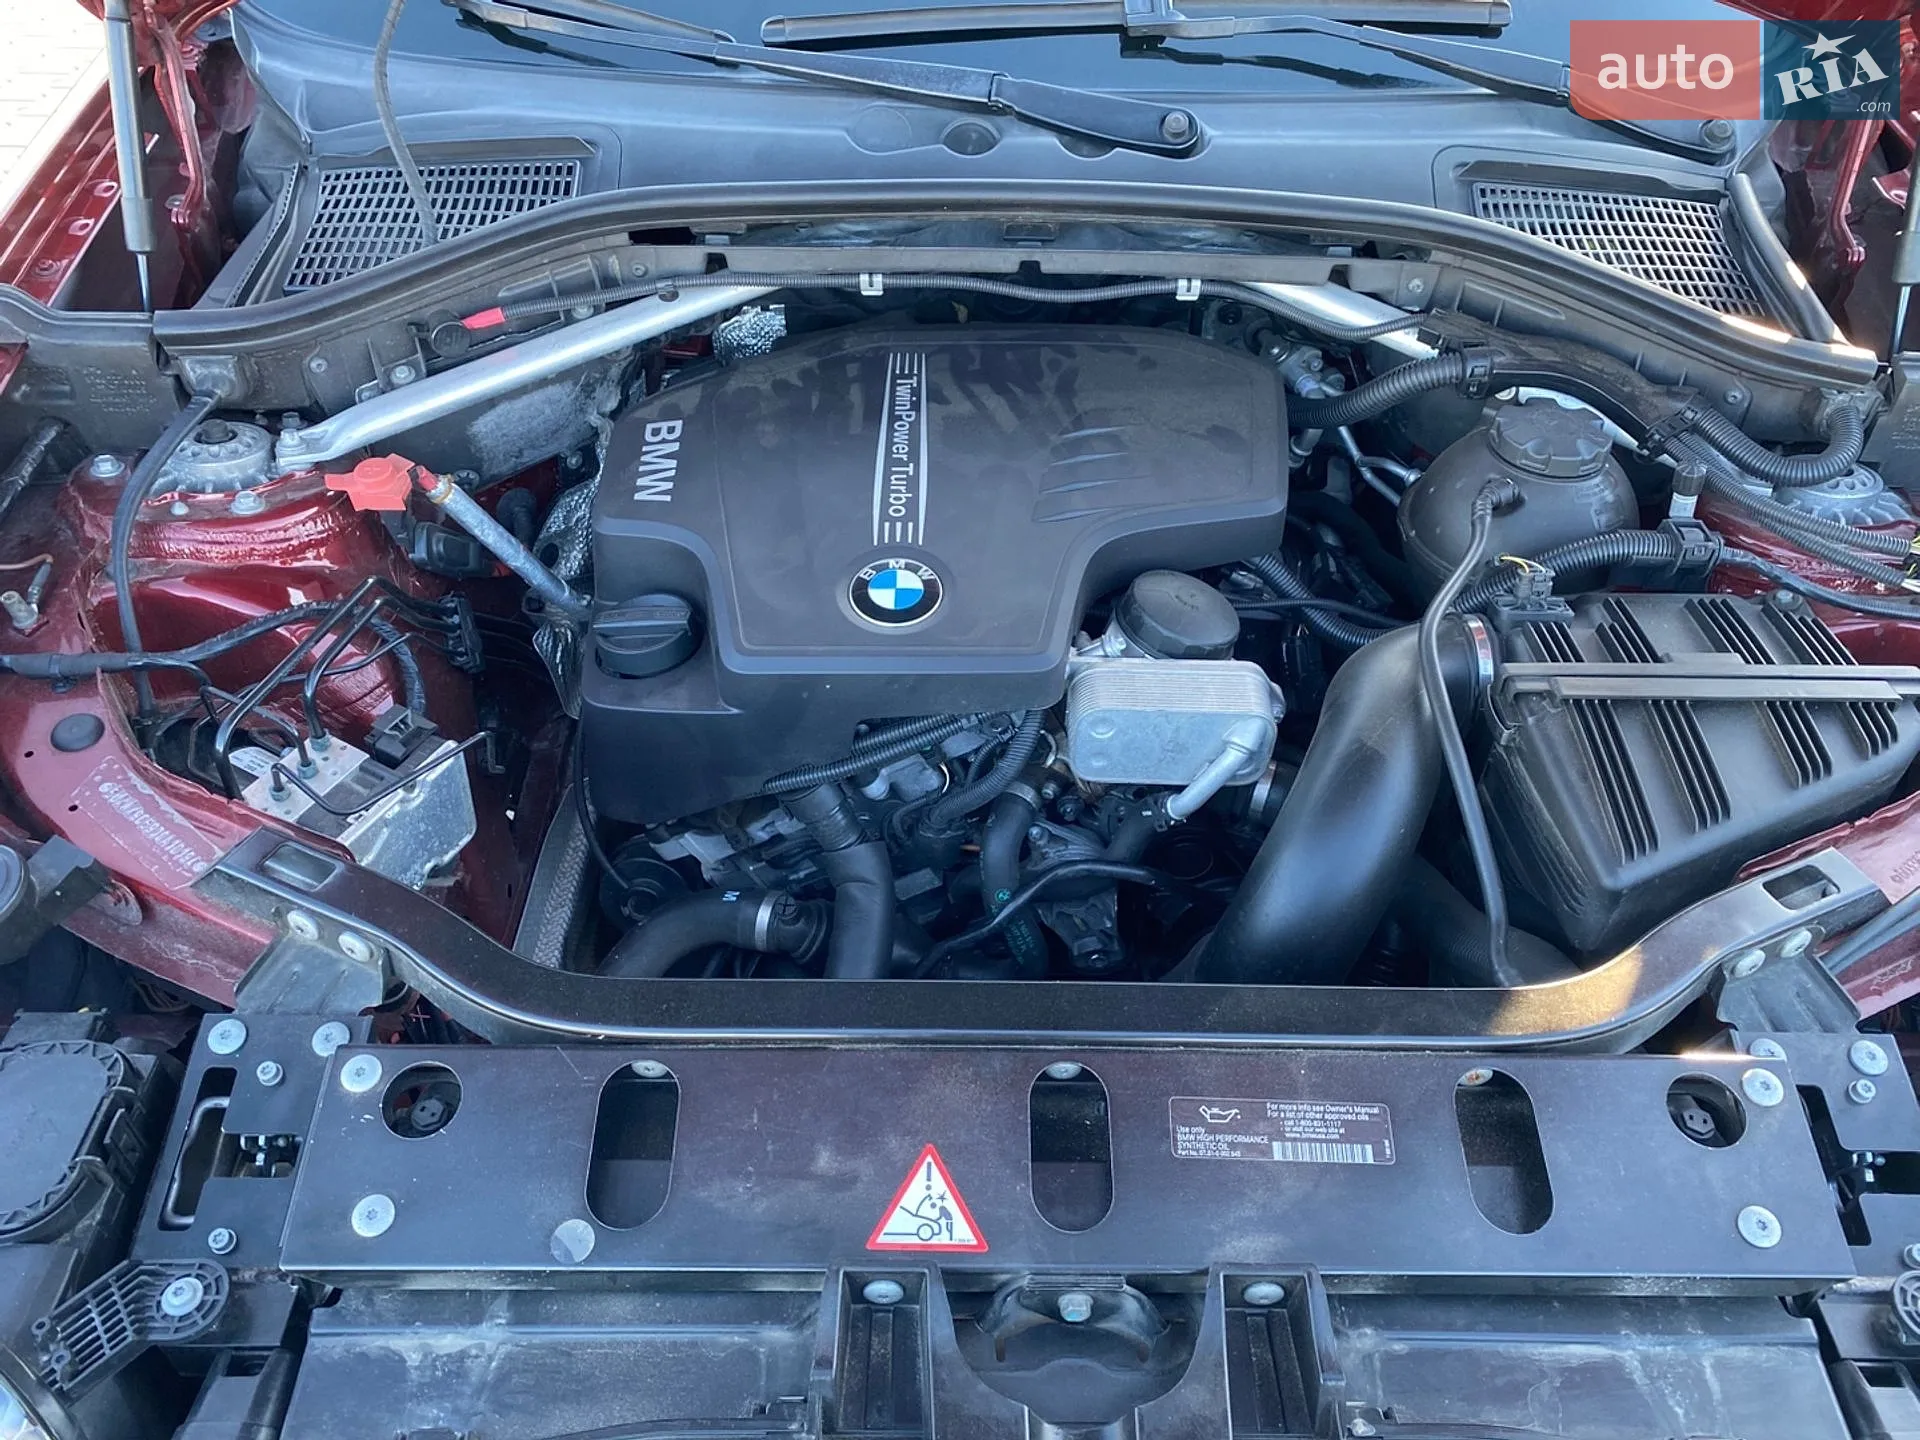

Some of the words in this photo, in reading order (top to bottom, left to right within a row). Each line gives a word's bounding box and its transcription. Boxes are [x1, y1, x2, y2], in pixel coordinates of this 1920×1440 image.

[892, 376, 917, 461] TwinPower
[634, 419, 683, 502] BMW
[888, 463, 914, 517] Turbo
[859, 558, 937, 581] BMW
[1266, 1102, 1278, 1110] For
[1298, 1103, 1312, 1111] info
[1325, 1104, 1353, 1113] Owner's
[1354, 1106, 1379, 1114] Manual
[1266, 1110, 1278, 1118] For
[1324, 1113, 1356, 1121] approved
[1177, 1141, 1217, 1151] SYNTHETIC
[1215, 1134, 1269, 1144] PERFORMANCE
